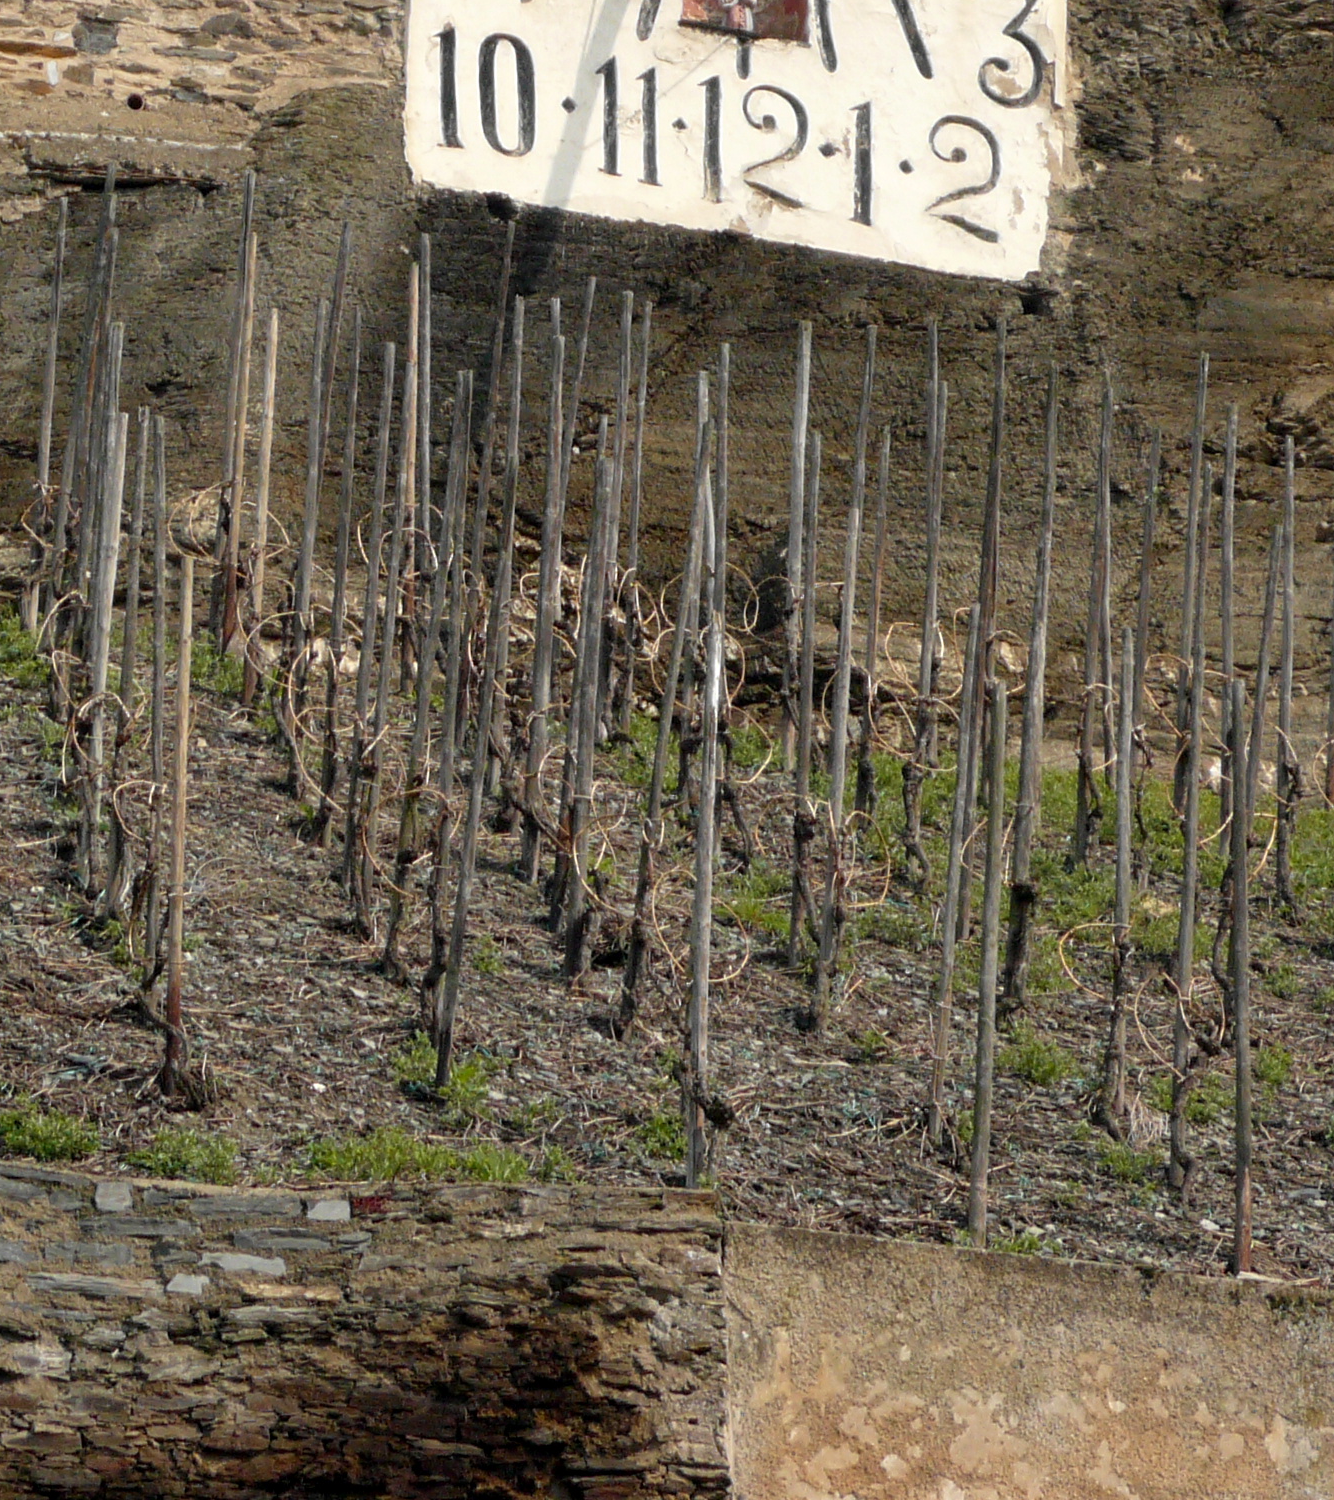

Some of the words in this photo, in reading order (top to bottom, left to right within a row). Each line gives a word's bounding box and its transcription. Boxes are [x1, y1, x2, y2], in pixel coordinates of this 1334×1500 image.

[434, 25, 536, 157] 10
[595, 56, 662, 187] 11
[699, 75, 808, 208] 12
[848, 101, 872, 226] 1
[925, 115, 1000, 243] 2
